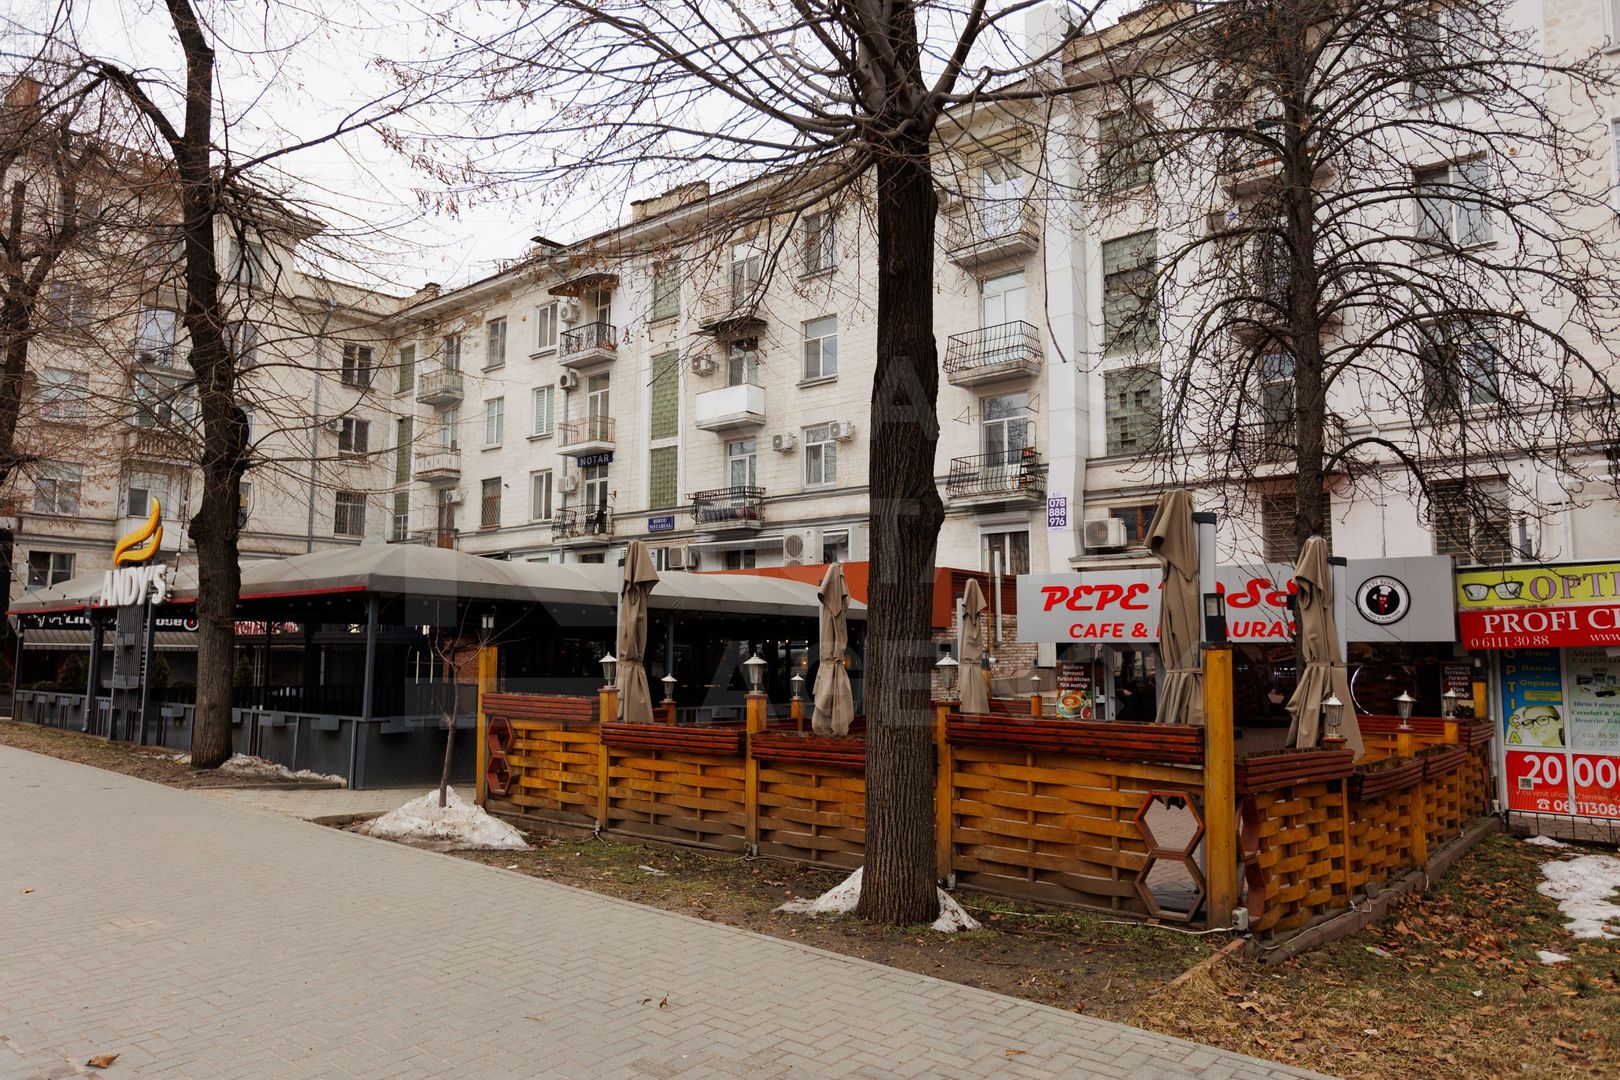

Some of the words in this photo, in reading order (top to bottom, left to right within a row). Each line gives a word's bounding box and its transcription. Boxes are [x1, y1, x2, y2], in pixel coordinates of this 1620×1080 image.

[580, 453, 609, 466] NOTAR
[1049, 498, 1066, 507] 078
[1049, 507, 1066, 516] 888
[649, 522, 672, 530] NOTARIAL
[1049, 517, 1065, 526] 976
[100, 563, 167, 607] ANDY'S
[1040, 583, 1149, 611] PEPE
[1482, 609, 1579, 634] PROFI
[1069, 623, 1124, 638] CAFE
[1131, 623, 1147, 638] &
